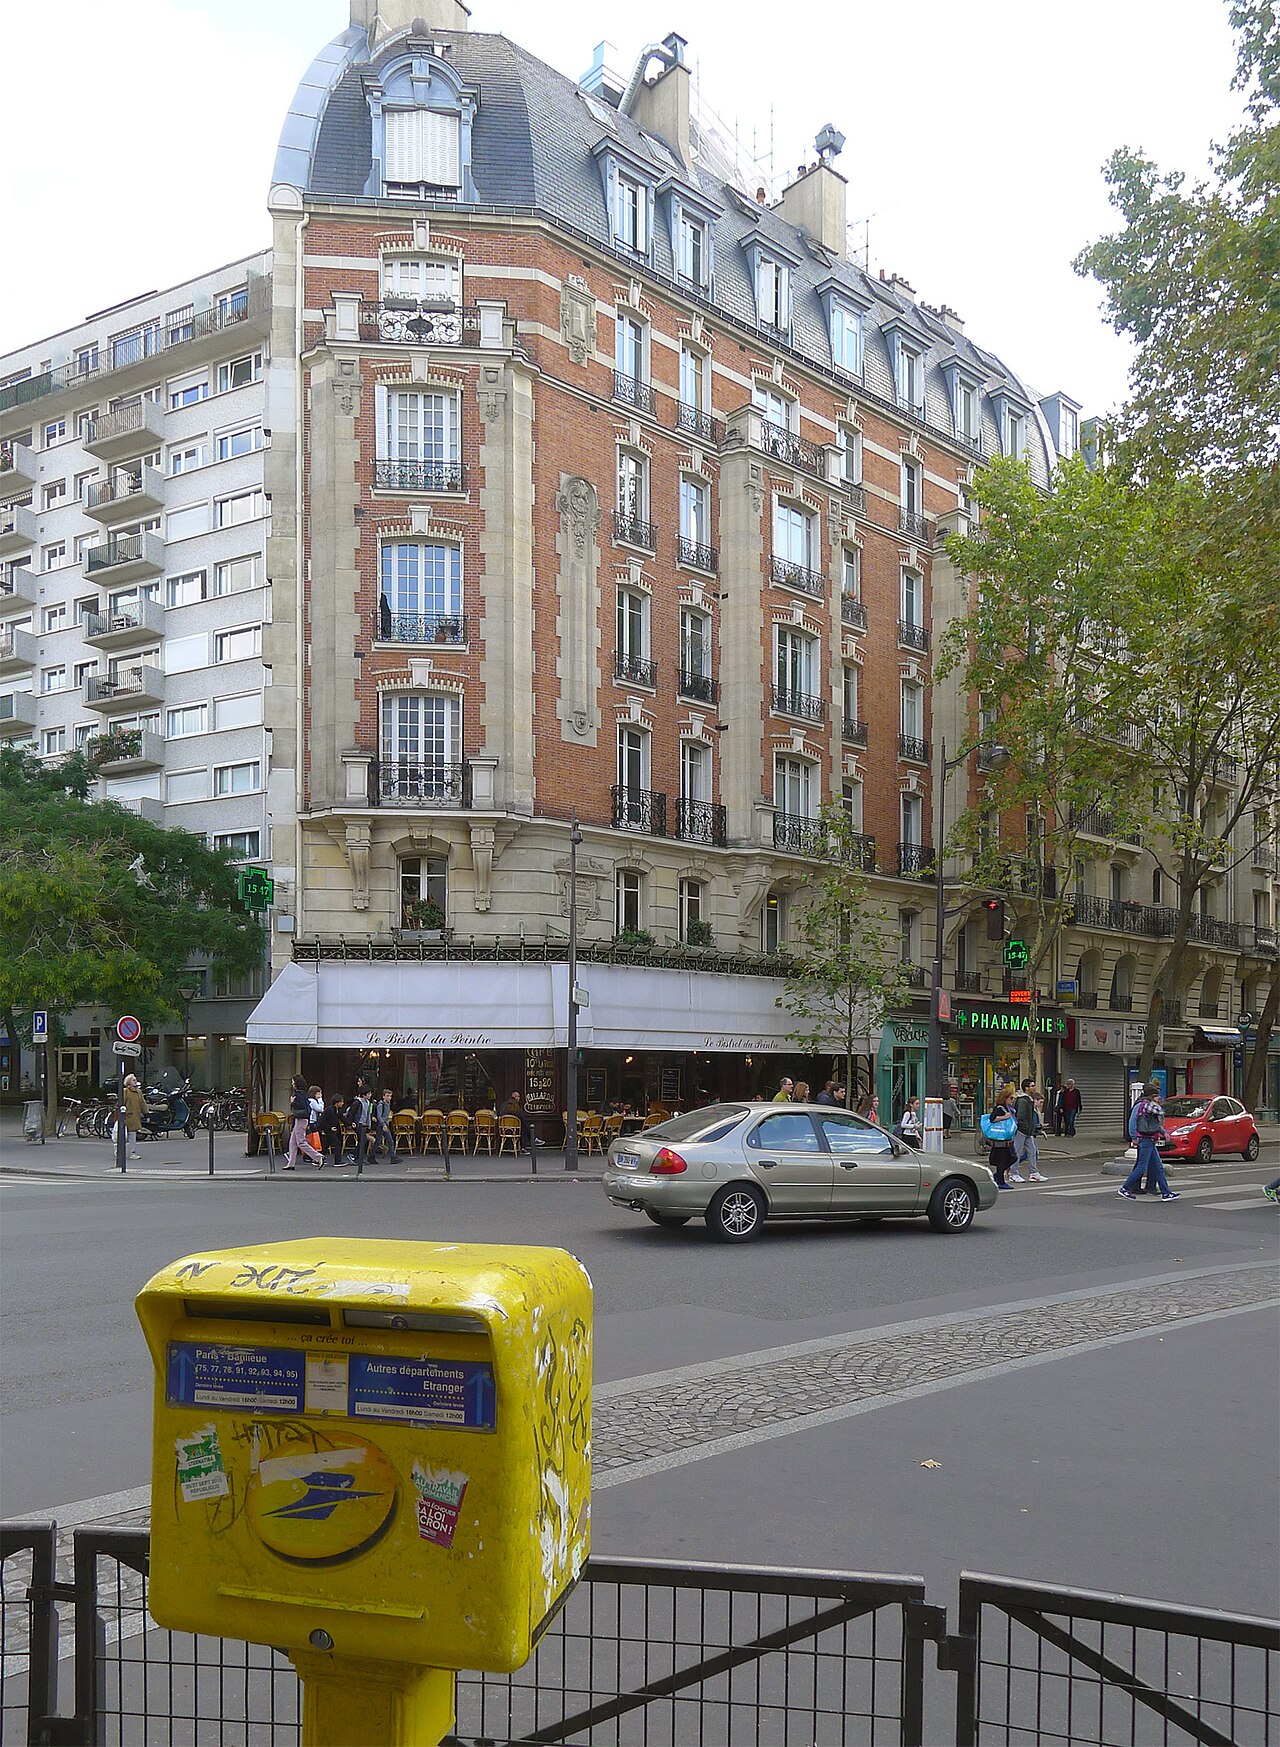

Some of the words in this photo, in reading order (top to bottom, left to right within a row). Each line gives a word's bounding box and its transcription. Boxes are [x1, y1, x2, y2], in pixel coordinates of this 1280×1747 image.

[36, 1016, 42, 1030] P
[366, 1032, 380, 1044] Le
[384, 1032, 428, 1044] Bistrot
[430, 1034, 446, 1044] du
[450, 1032, 492, 1044] Peintre
[704, 1036, 714, 1047] Le
[716, 1038, 742, 1048] Bistrot
[754, 1040, 779, 1049] Peintre
[300, 1334, 312, 1343] ça
[316, 1335, 338, 1344] crée
[196, 1350, 218, 1360] Paris
[228, 1352, 268, 1364] Banlieue
[286, 1370, 298, 1379] 95)
[366, 1362, 397, 1374] Autres
[400, 1364, 464, 1380] départements
[423, 1380, 464, 1394] Etranger
[382, 1408, 404, 1416] Vendredi
[428, 1480, 459, 1497] TRAVAIL
[428, 1508, 446, 1522] LOI
[420, 1516, 448, 1532] CRON
